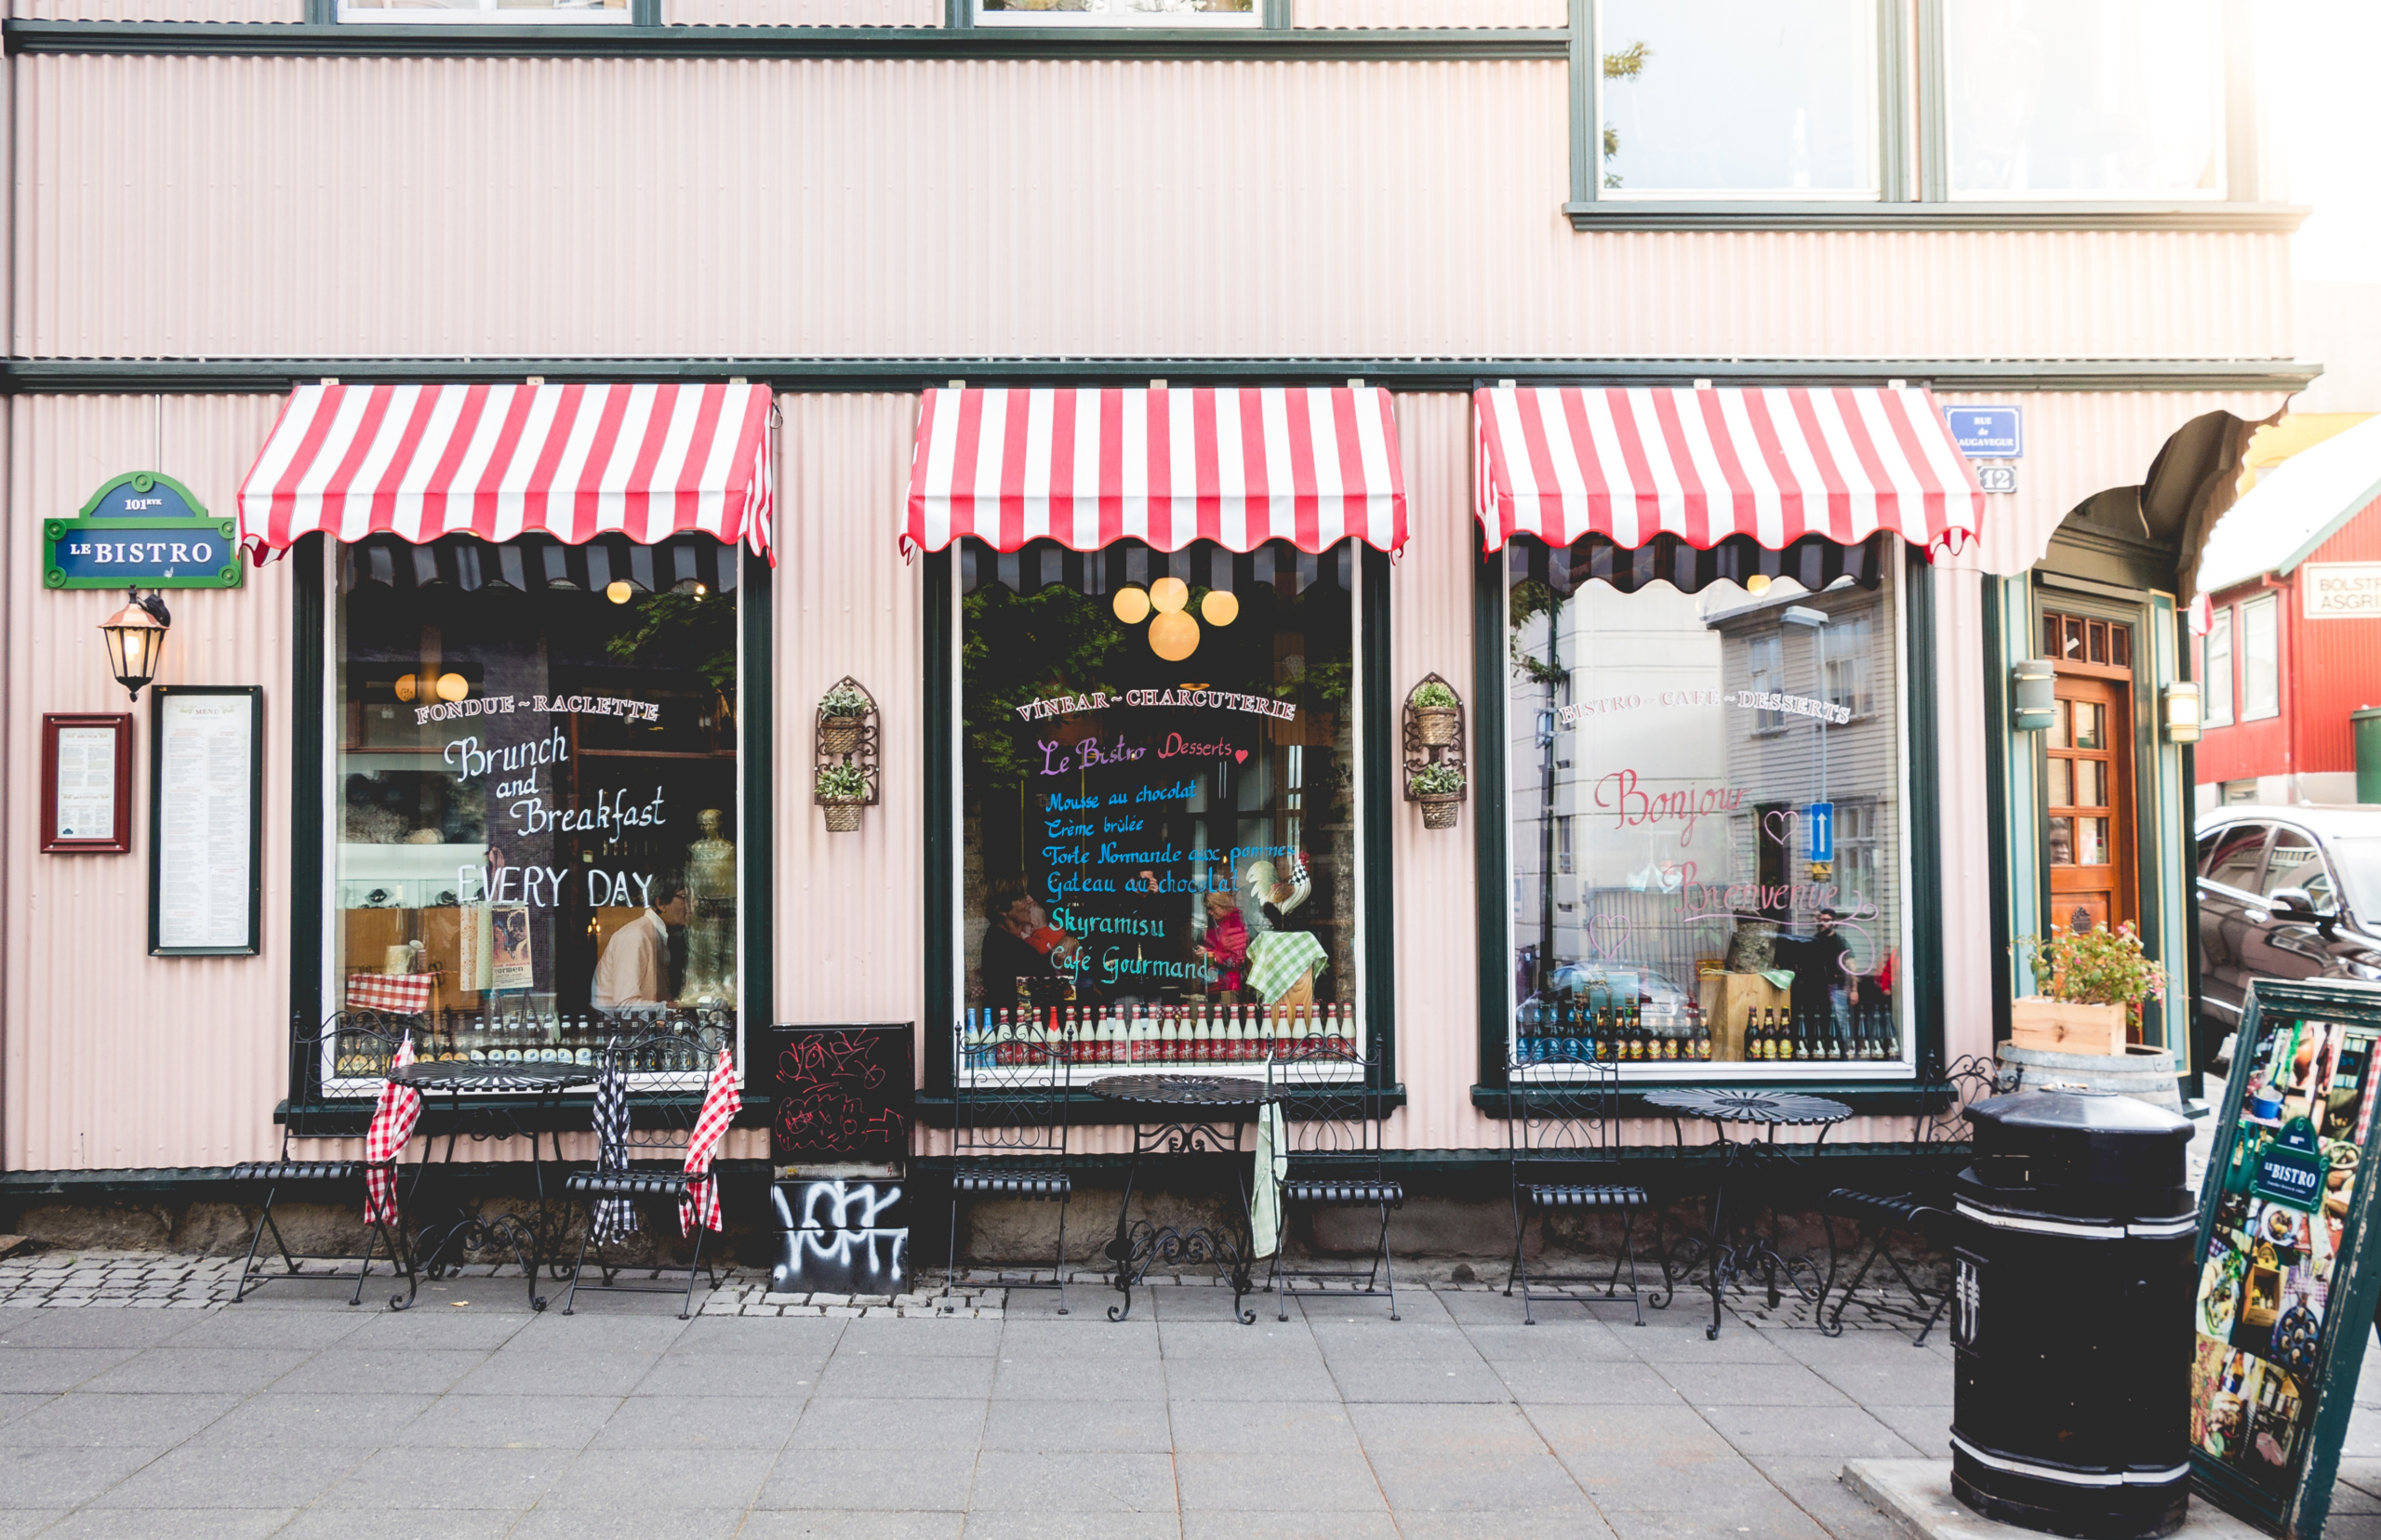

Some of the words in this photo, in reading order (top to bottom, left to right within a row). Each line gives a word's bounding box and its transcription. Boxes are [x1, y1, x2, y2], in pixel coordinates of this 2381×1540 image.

[1974, 417, 1992, 425] RUE
[1958, 438, 2014, 446] AUGAVEGUR
[1983, 469, 2010, 488] 12
[70, 543, 91, 555] LE
[95, 543, 212, 563] BISTRO
[415, 695, 514, 725] FONDUE
[533, 695, 659, 722] RACLETTE
[1017, 691, 1110, 722] VÍNBAR
[1125, 688, 1297, 722] CHARCUTERIE
[1558, 693, 1642, 724] BISTRO
[1660, 686, 1721, 707] CAFÉ
[1737, 690, 1851, 725] DESSERTS
[444, 725, 569, 783] Brunch
[1037, 738, 1070, 776] Le
[1075, 734, 1147, 770] Bistro
[1157, 732, 1232, 760] Desserts
[496, 767, 539, 799] and
[1045, 792, 1100, 812] Mousse
[1108, 791, 1128, 806] au
[1136, 779, 1197, 803] chocolat
[510, 786, 666, 843] Breakfast
[1594, 768, 1752, 848] Bonjour
[1044, 819, 1095, 838] Crème
[1103, 815, 1144, 833] brûlée
[1042, 845, 1089, 866] Torte
[1097, 841, 1182, 866] Normande
[1188, 847, 1221, 861] aux
[1230, 844, 1296, 872] pommes
[458, 864, 568, 908] EVERY
[588, 869, 653, 909] DAY
[1045, 870, 1116, 903] Gateau
[1124, 874, 1150, 893] au
[1158, 866, 1241, 894] chocolat
[1662, 861, 1840, 914] Bienvenue
[1051, 945, 1093, 985] Café
[1100, 946, 1217, 985] Gourmand
[2264, 1162, 2273, 1171] LE
[2271, 1163, 2316, 1188] BISTRO
